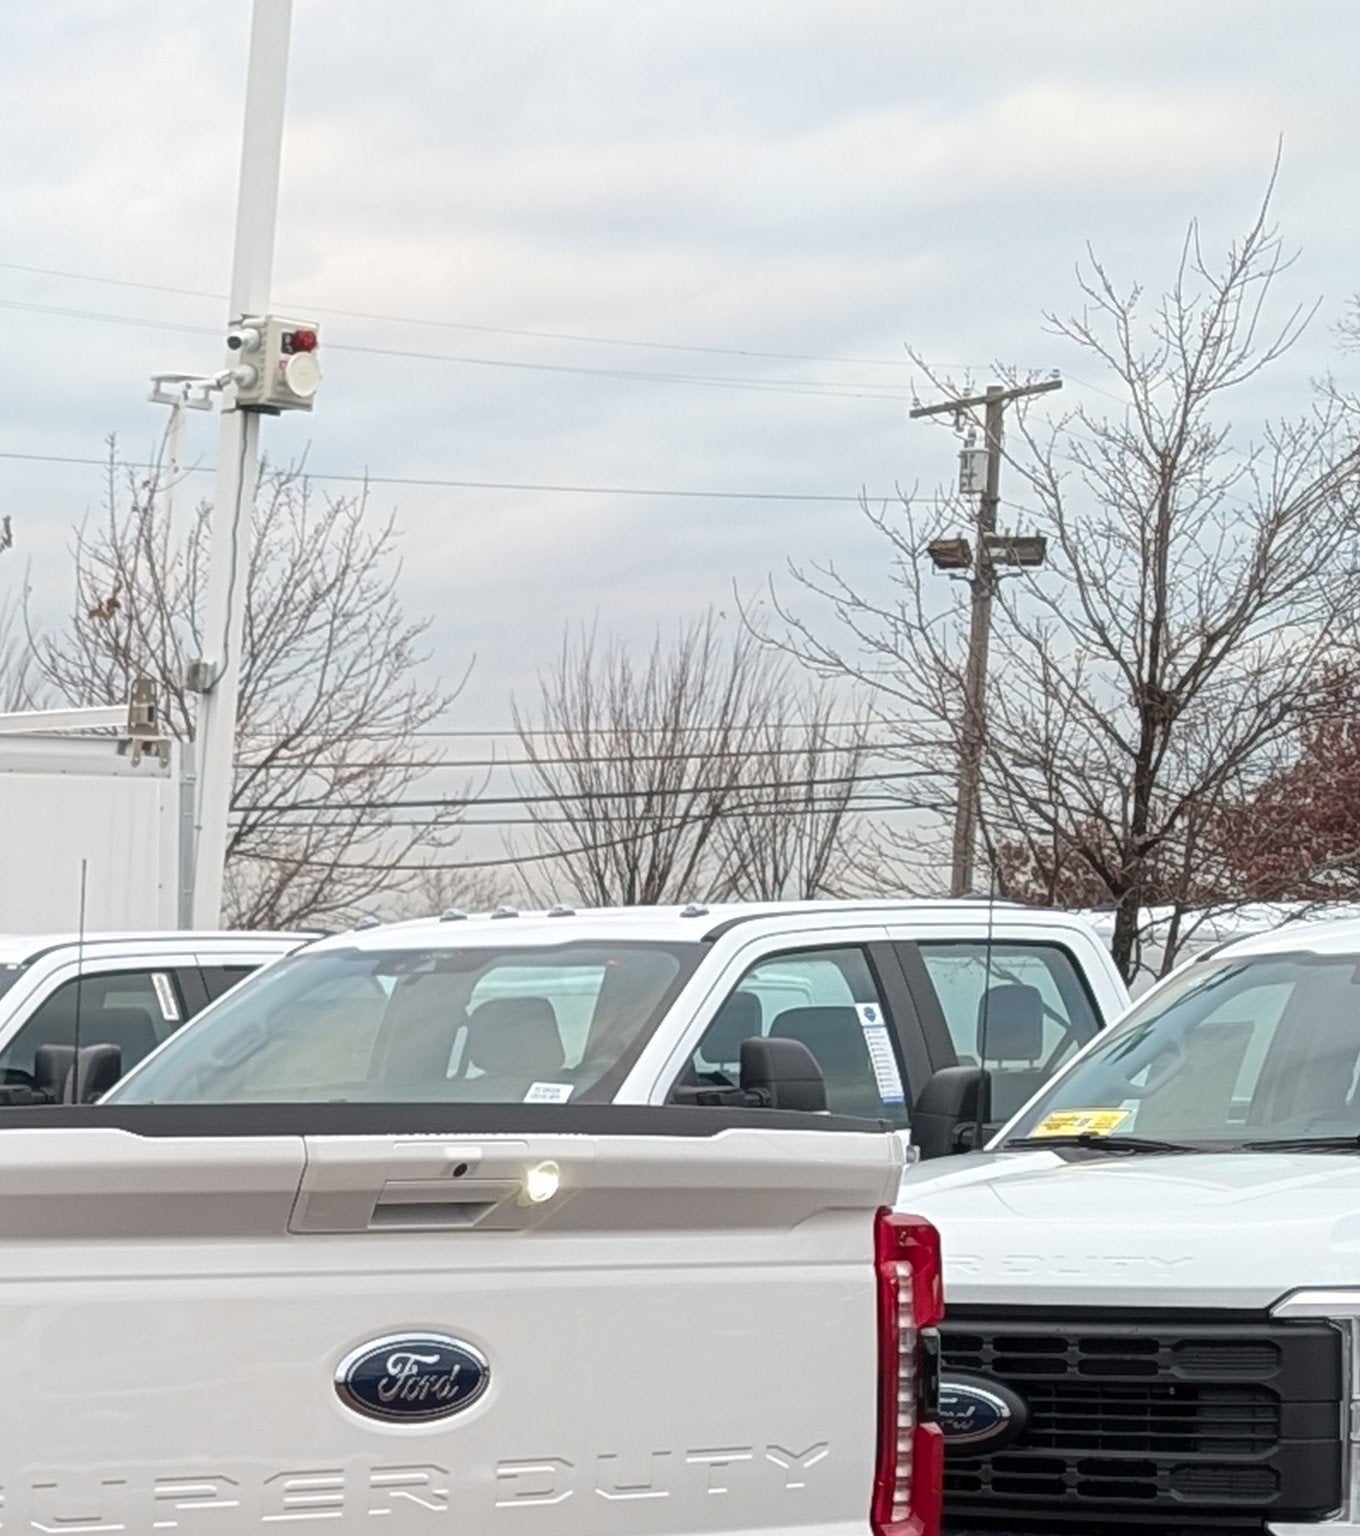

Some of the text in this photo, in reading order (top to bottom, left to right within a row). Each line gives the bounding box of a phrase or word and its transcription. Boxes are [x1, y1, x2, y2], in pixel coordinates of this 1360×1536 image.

[997, 1254, 1194, 1277] DUTY
[378, 1352, 461, 1402] Ford
[495, 1442, 829, 1507] DUTY
